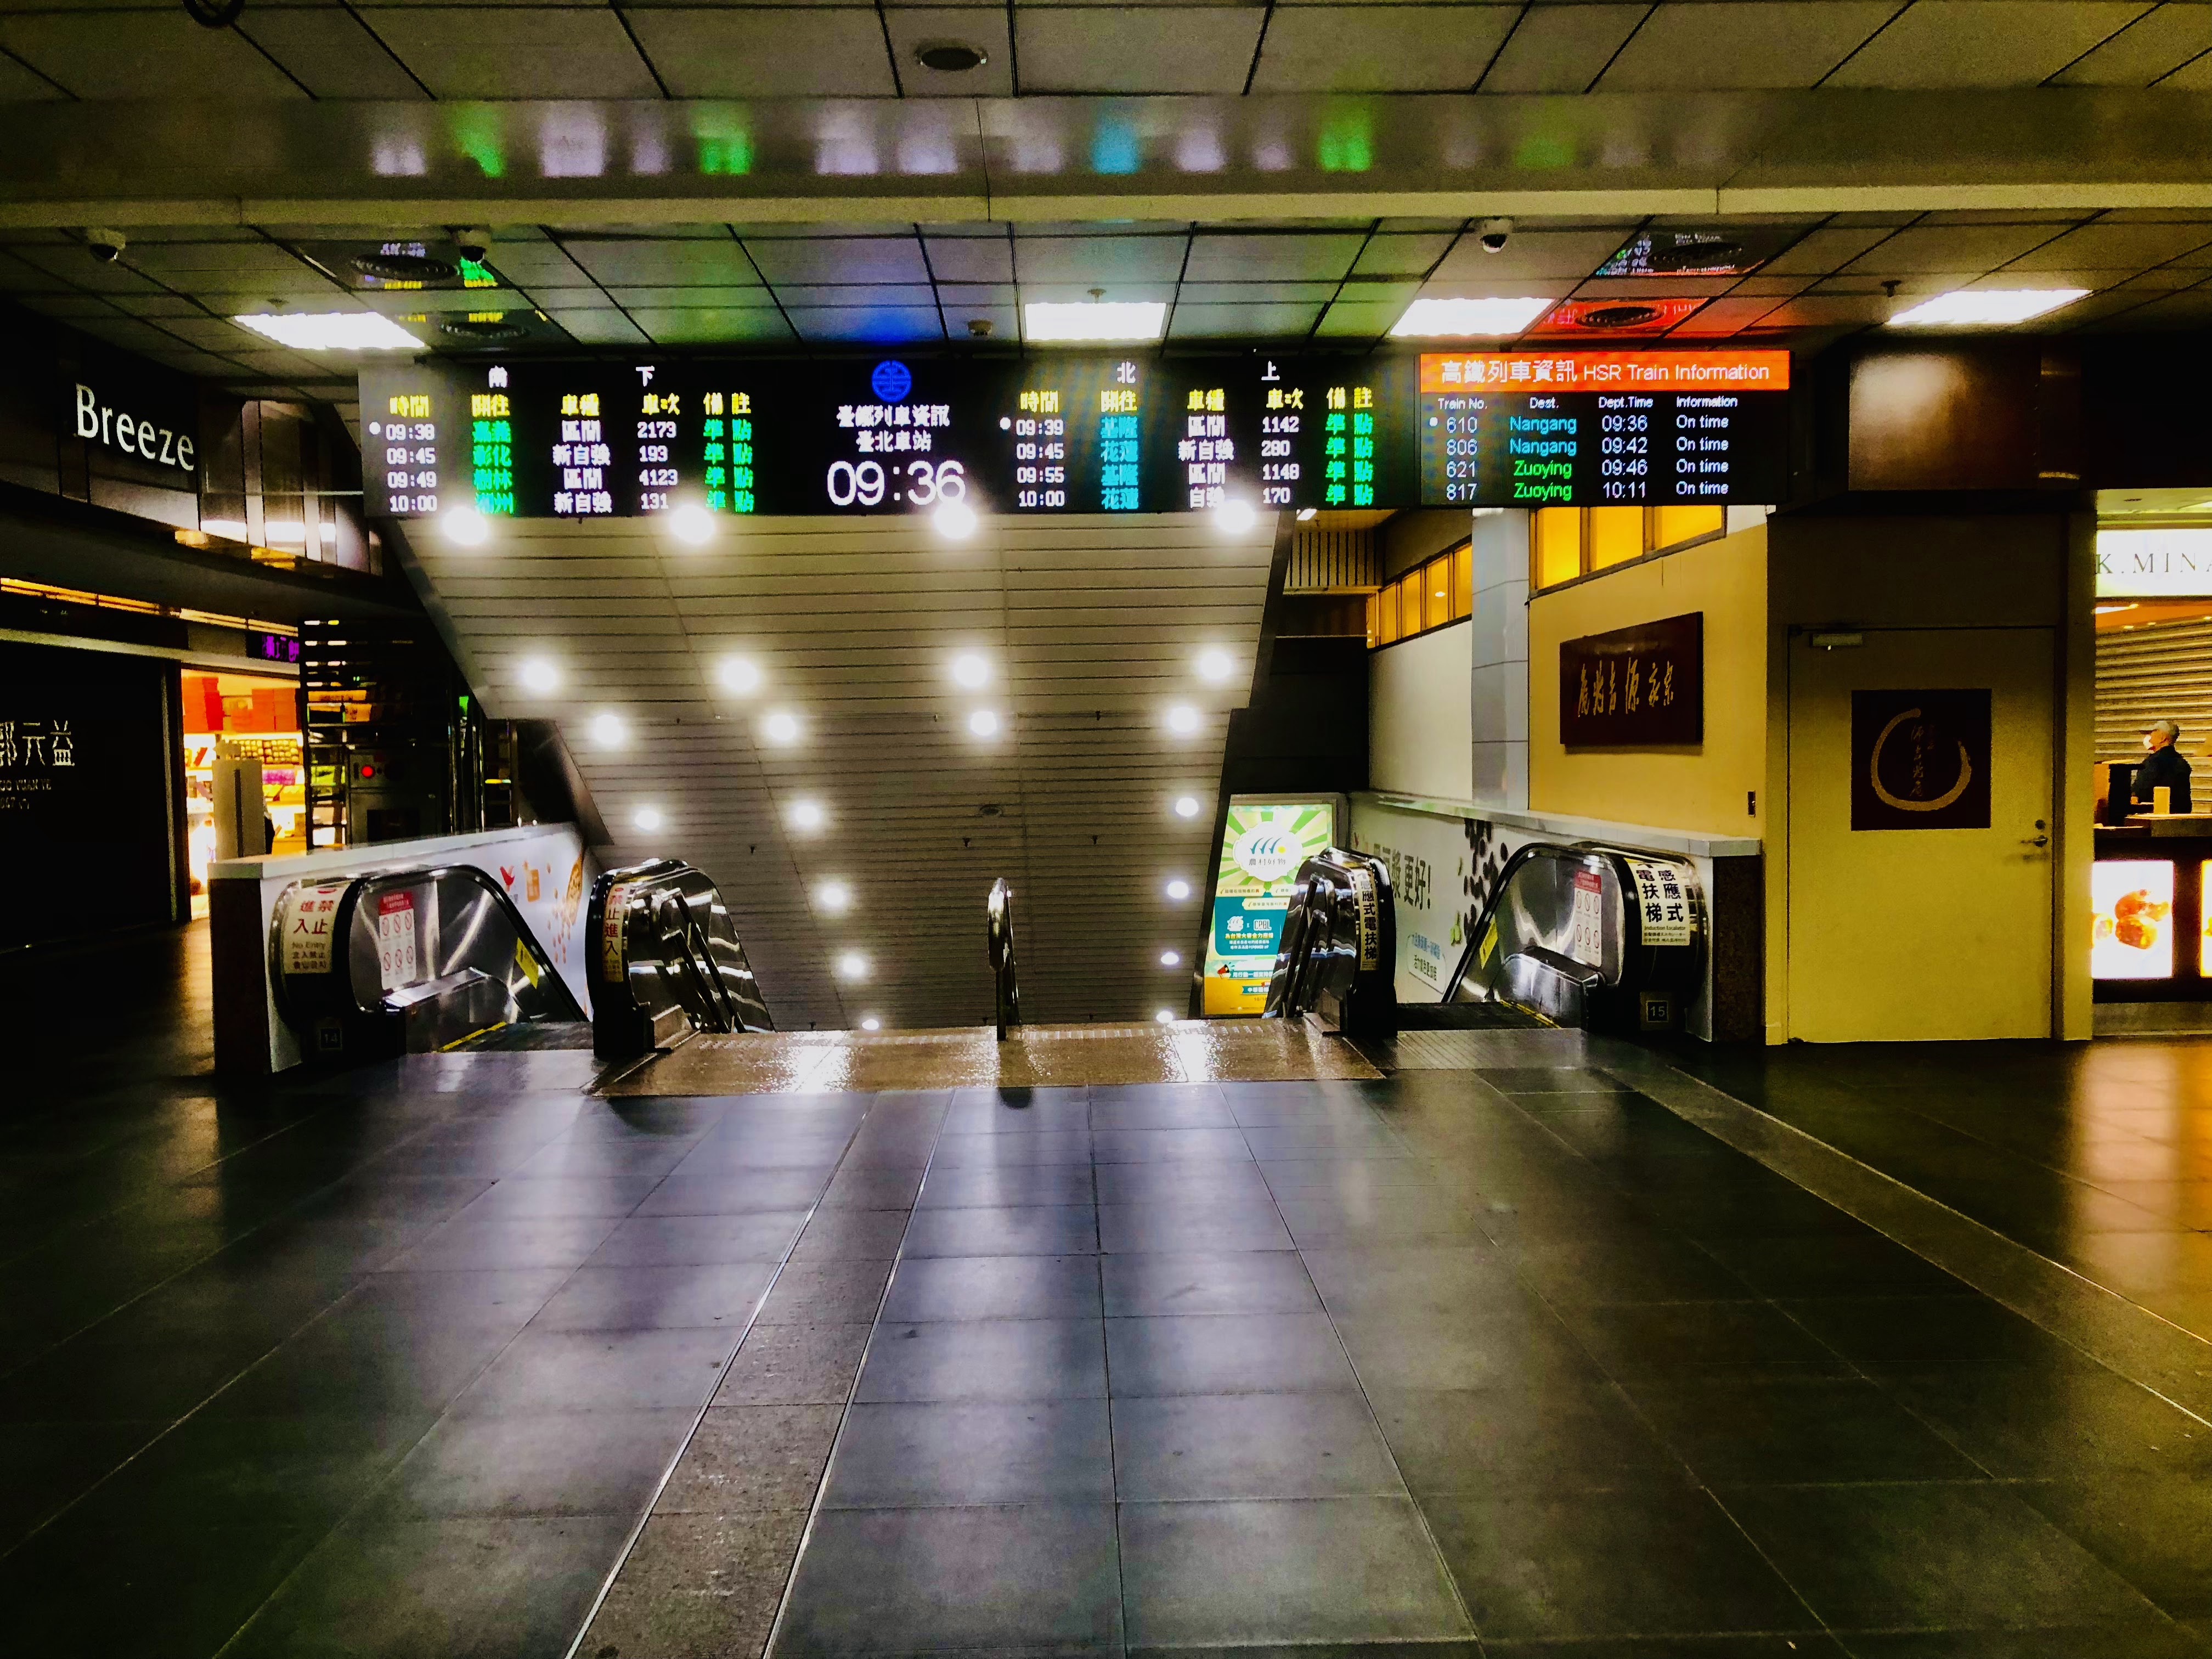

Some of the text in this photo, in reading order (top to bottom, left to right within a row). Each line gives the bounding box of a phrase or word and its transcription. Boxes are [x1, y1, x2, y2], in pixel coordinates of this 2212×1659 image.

[488, 365, 655, 388] 南 下
[1117, 360, 1280, 383] 北 上
[1441, 360, 1769, 383] 高鐵列車資訊 HSR Train Information
[390, 392, 752, 417] 時間 開往 車種 車次 備註
[1020, 387, 1373, 413] 時間 開往 車種 車次 備註
[1438, 398, 1465, 410] Train
[1469, 398, 1488, 409] No.
[1530, 397, 1559, 409] Dest.
[1676, 396, 1738, 408] Information
[76, 383, 194, 471] Breeze
[837, 405, 950, 427] 臺鐵列車資訊
[1016, 413, 1373, 438] 09:39 基隆 區間 1142 準點
[1447, 415, 1729, 435] 610 Nangang 09:36 On time
[386, 424, 435, 440] 09:38
[562, 420, 601, 441] 區間
[637, 421, 676, 438] 2173
[703, 419, 752, 441] 準點
[856, 431, 932, 452] 臺北車站
[387, 448, 436, 465] 09:45
[552, 444, 611, 466] 新自強
[639, 445, 668, 462] 193
[704, 443, 753, 465] 準點
[1017, 437, 1373, 462] 09:45 花蓮 新自強 280 準點
[1447, 437, 1729, 456] 806 Nangang 09:42 On time
[388, 471, 437, 488] 09:49
[563, 468, 602, 490] 區間
[639, 469, 678, 486] 4123
[705, 466, 754, 488] 準點
[1017, 460, 1373, 486] 09:55 基隆 區間 1148 準點
[1447, 460, 1729, 479] 621 Zuoying 09:46 On time
[827, 460, 966, 506] 09:36
[1446, 482, 1729, 501] 817 Zuoying 10:11 On time
[390, 495, 437, 512] 10:00
[554, 492, 612, 514] 新自強
[641, 493, 669, 510] 131
[706, 490, 755, 512] 準點
[1019, 484, 1373, 510] 10:00 花蓮 自強 170 準點
[2096, 552, 2212, 574] K.MIN
[1254, 920, 1270, 929] CPBL
[1650, 1006, 1666, 1017] 15
